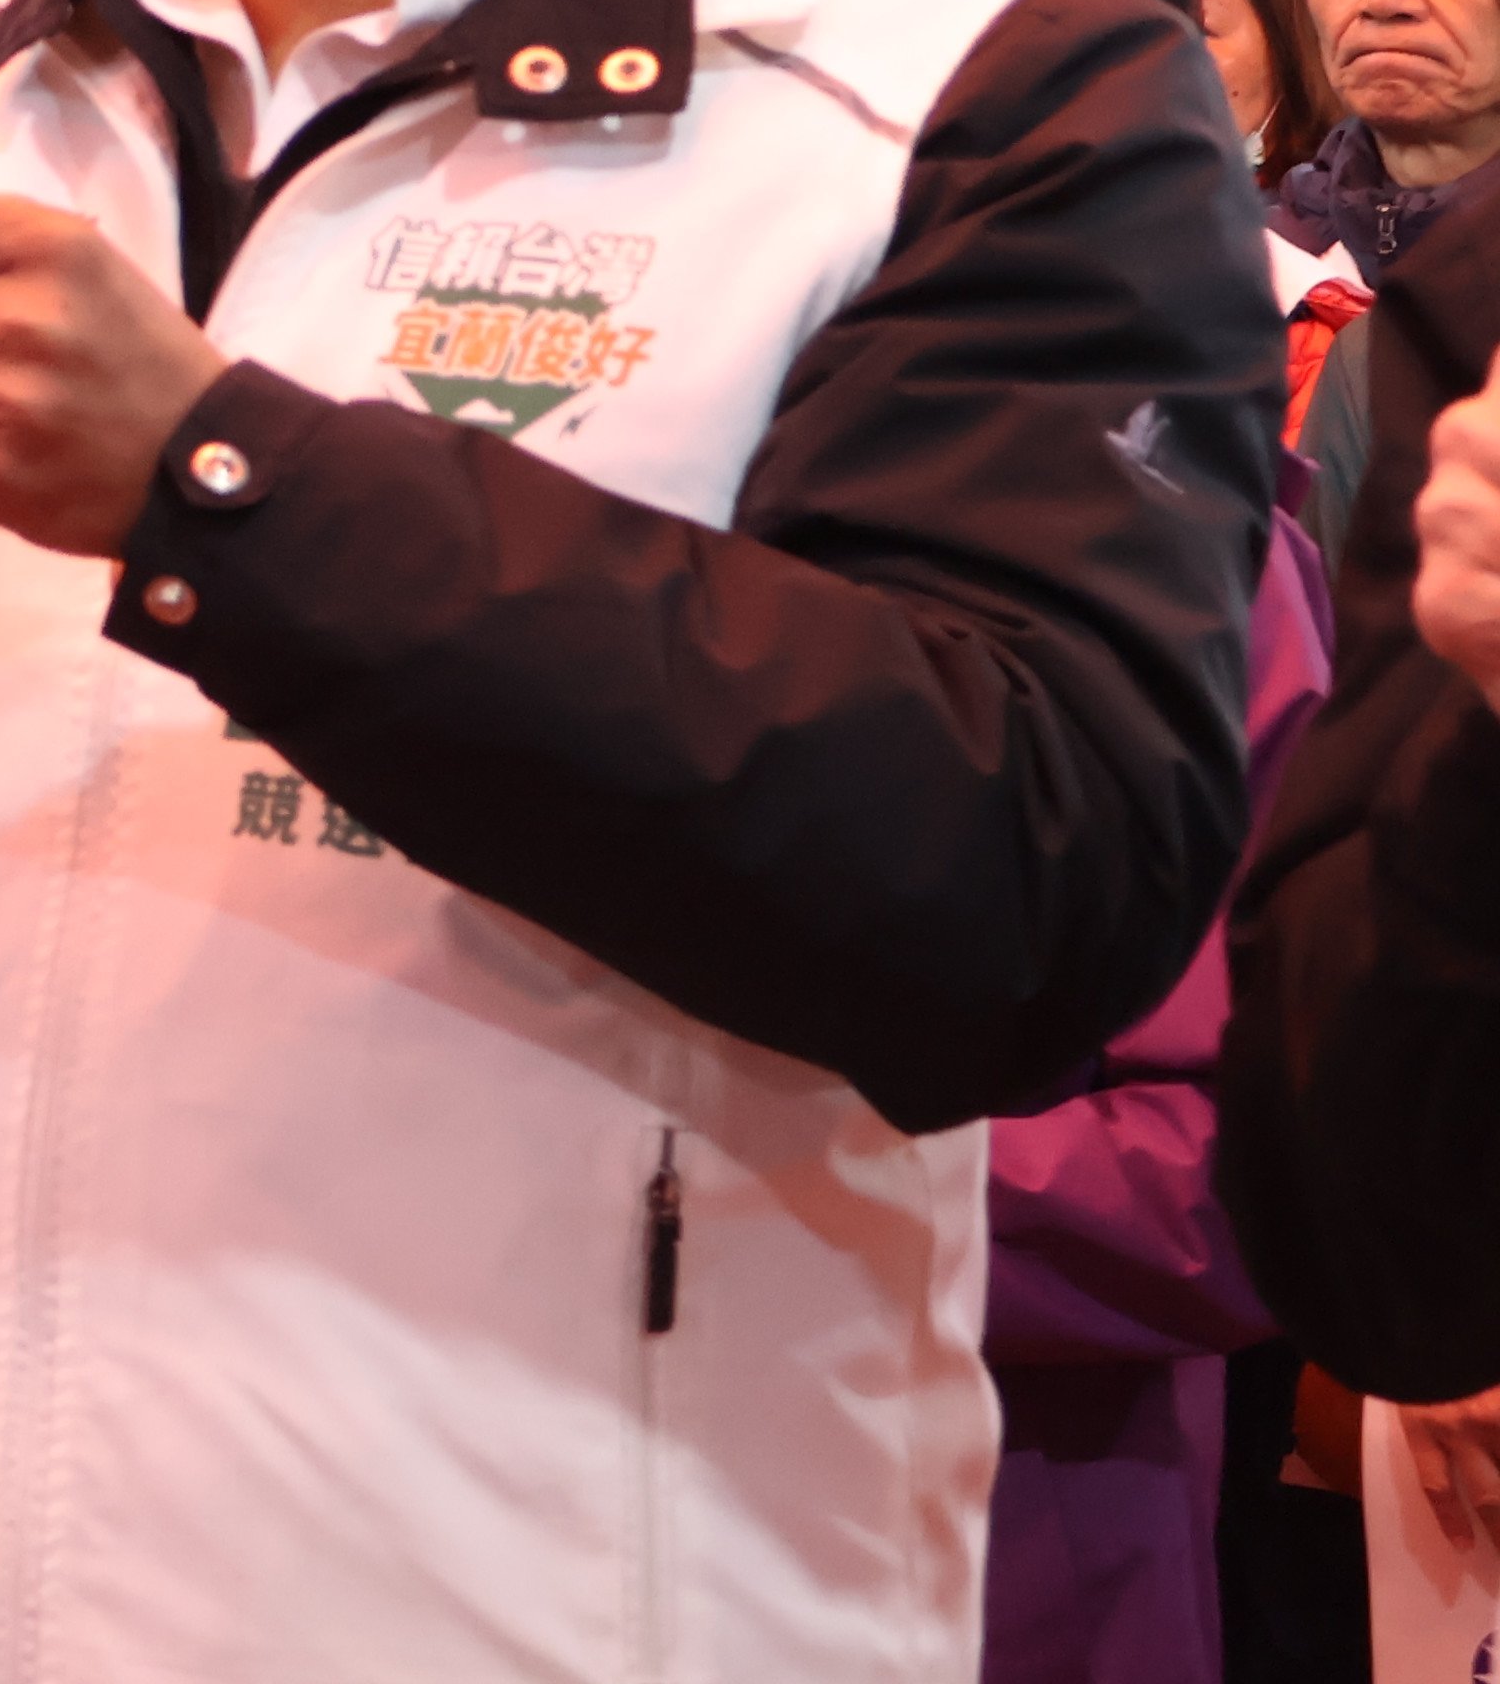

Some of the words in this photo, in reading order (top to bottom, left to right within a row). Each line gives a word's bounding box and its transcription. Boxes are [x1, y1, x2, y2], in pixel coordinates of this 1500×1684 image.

[365, 215, 657, 304] 信賴台灣
[378, 305, 658, 388] 宜蘭俊好
